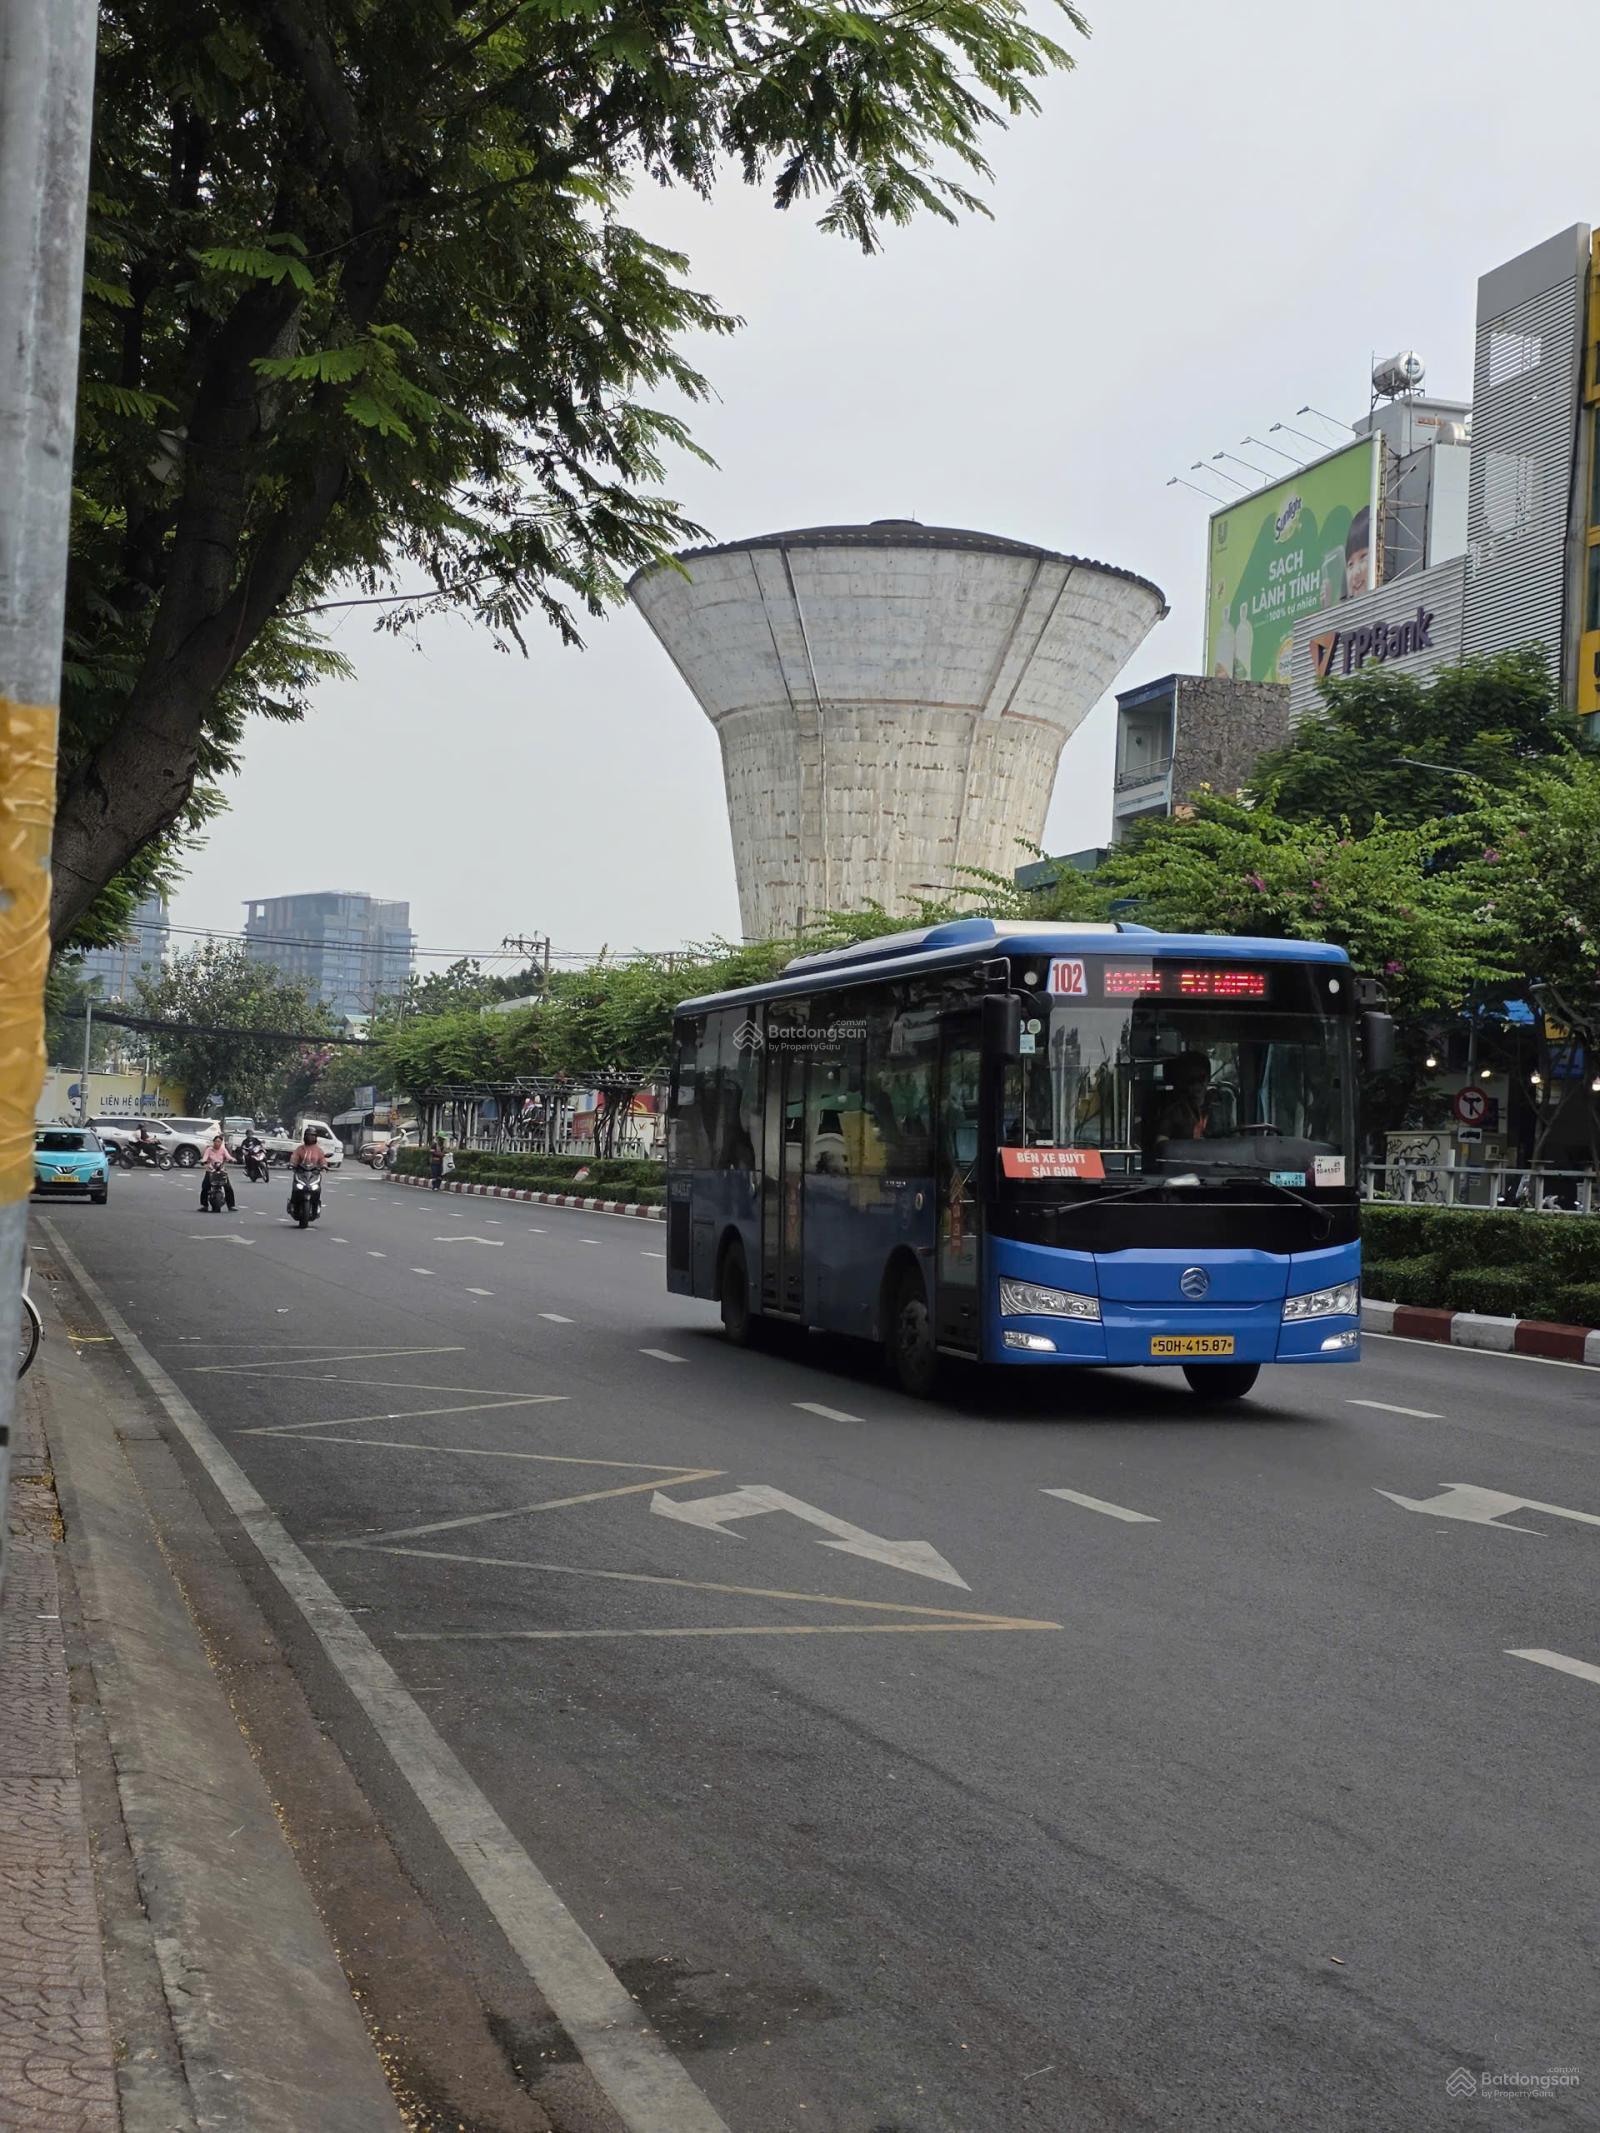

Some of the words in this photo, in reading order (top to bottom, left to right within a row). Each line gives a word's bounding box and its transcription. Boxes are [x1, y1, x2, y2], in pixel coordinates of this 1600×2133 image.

[1275, 498, 1302, 540] Sunlight
[1269, 549, 1303, 583] SẠCH
[1252, 585, 1286, 614] LÀNH
[1289, 569, 1320, 600] TÍNH
[1341, 607, 1434, 674] TPBank
[1053, 964, 1083, 993] 102
[100, 1095, 119, 1106] LIÊN
[1041, 1153, 1056, 1163] XE
[1060, 1152, 1086, 1164] BUÝT
[1158, 1340, 1227, 1352] 50H-415.87
